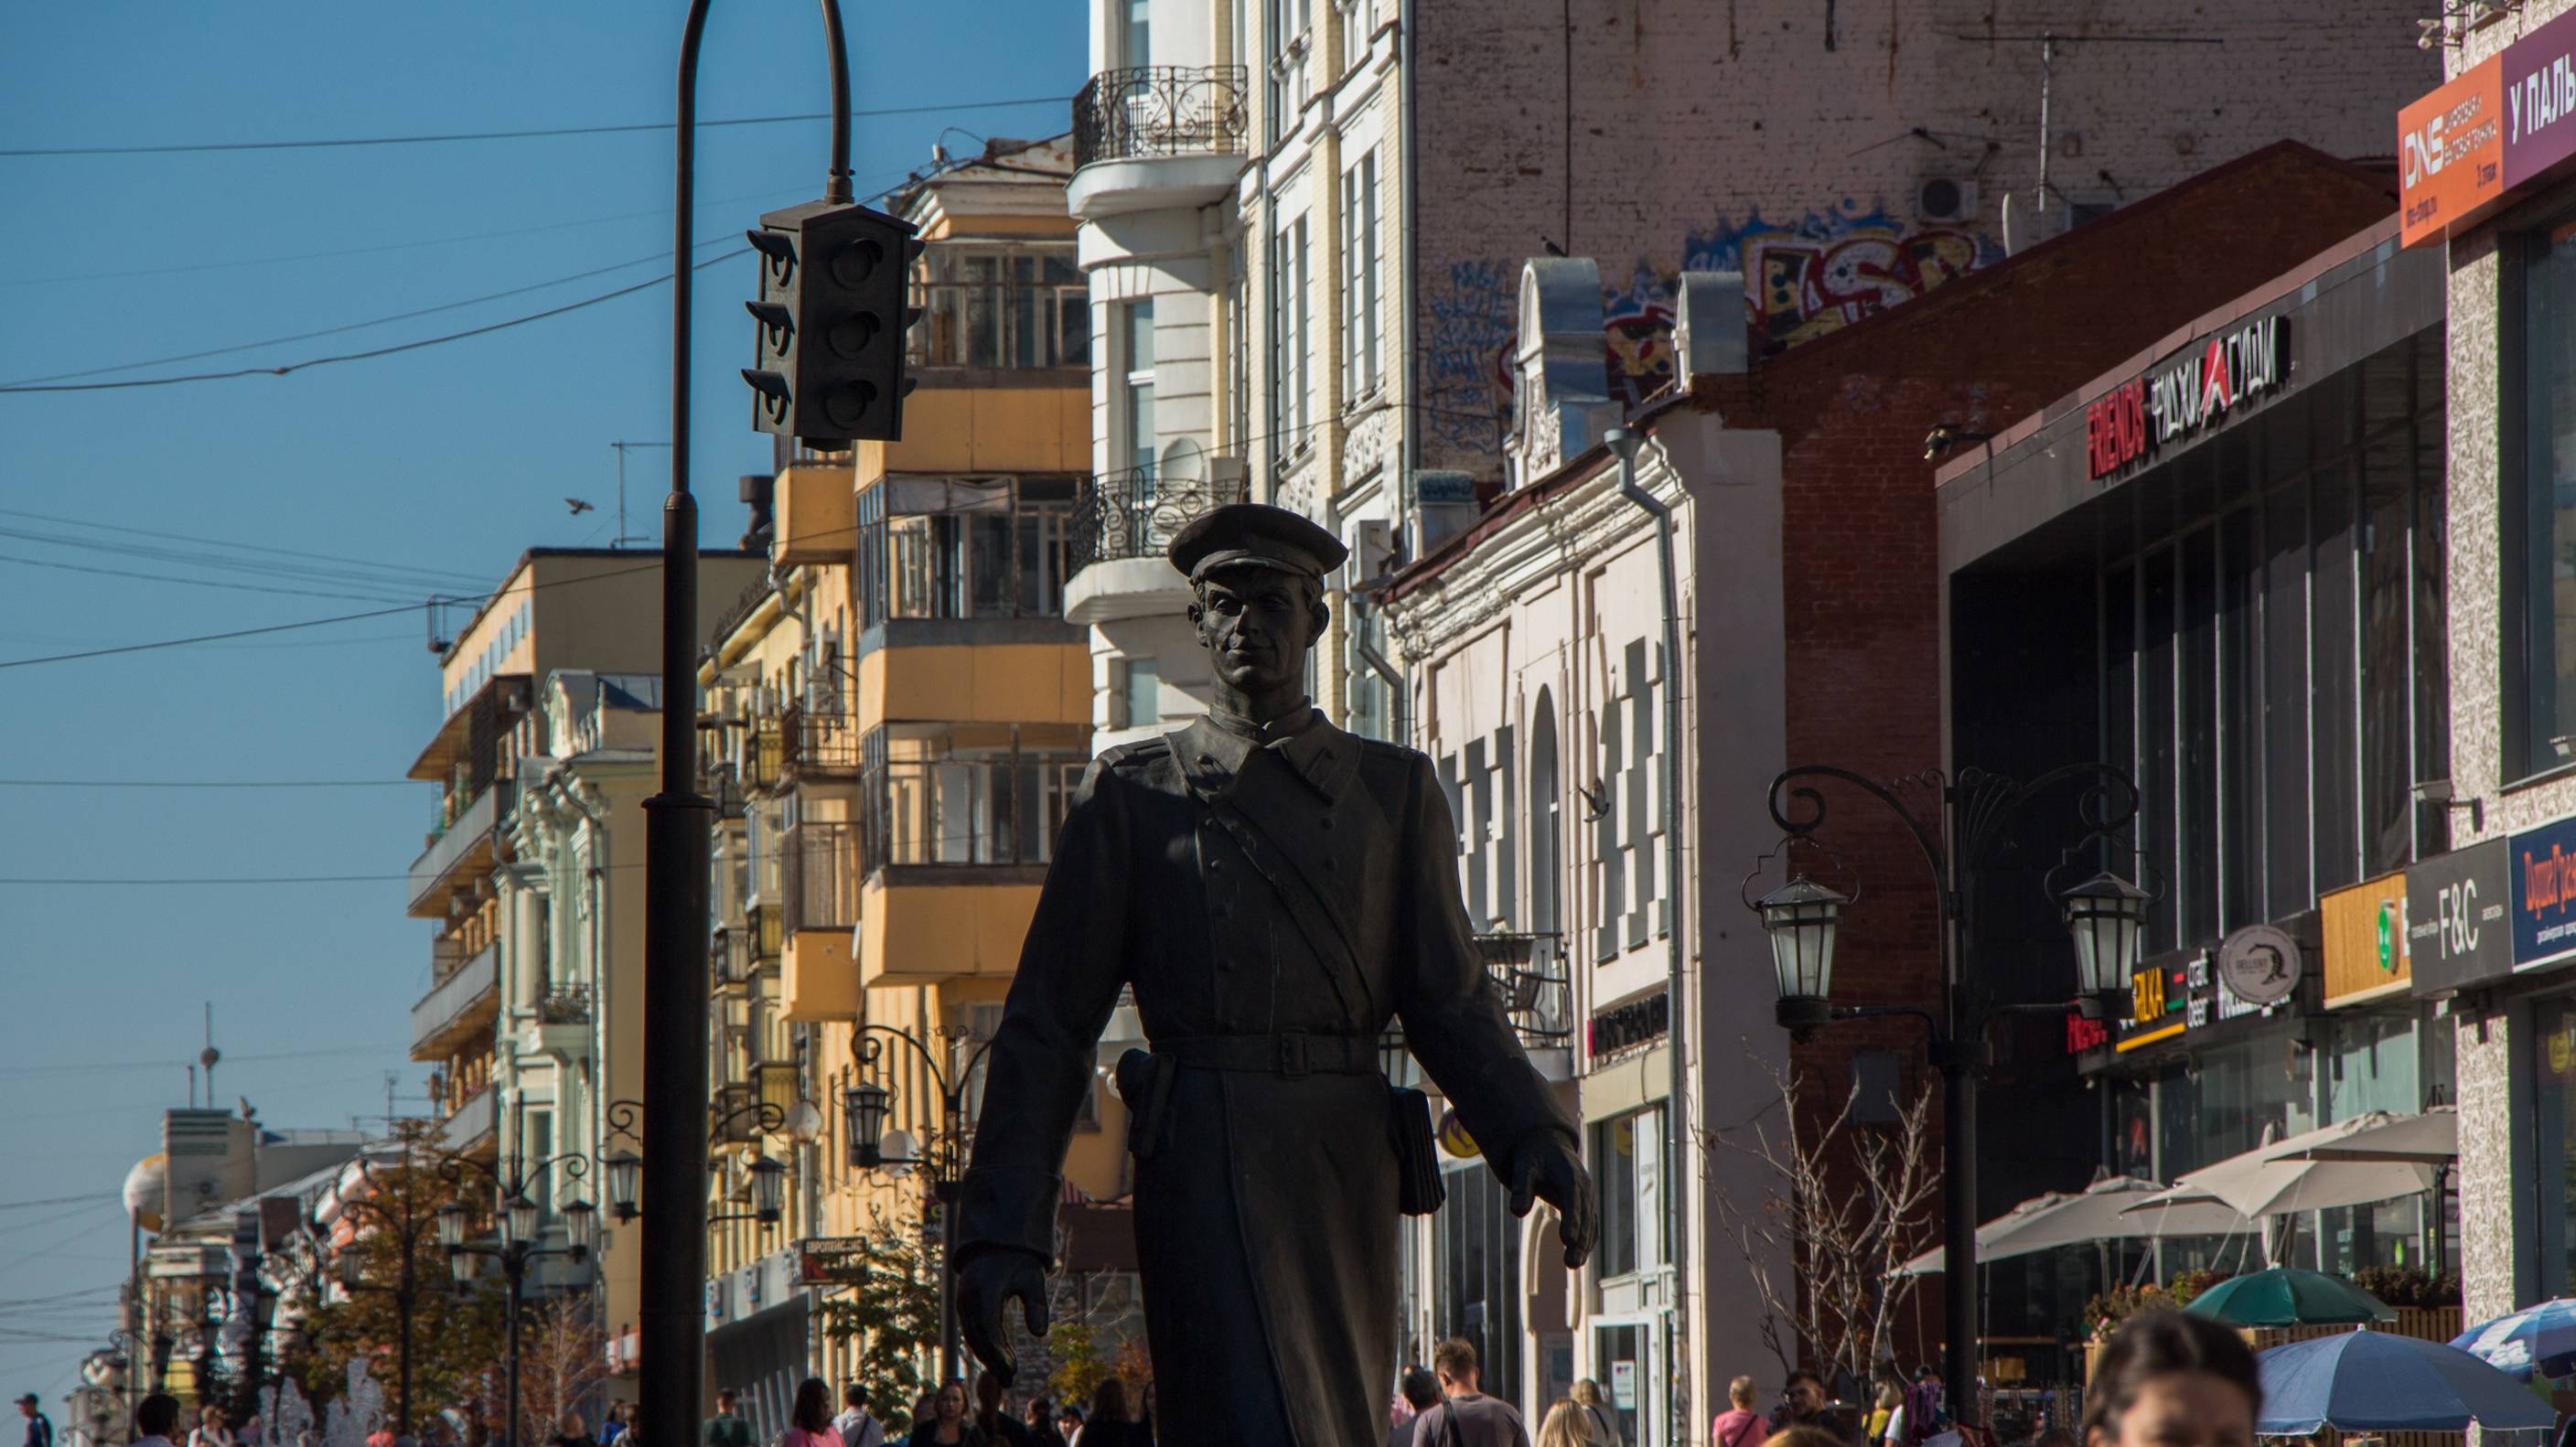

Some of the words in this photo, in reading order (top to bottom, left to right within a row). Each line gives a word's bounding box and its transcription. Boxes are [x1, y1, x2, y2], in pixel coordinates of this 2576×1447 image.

[2510, 80, 2522, 145] У
[2404, 114, 2444, 190] DNS
[2088, 375, 2144, 481] FRIENDS
[2439, 878, 2479, 959] F&C
